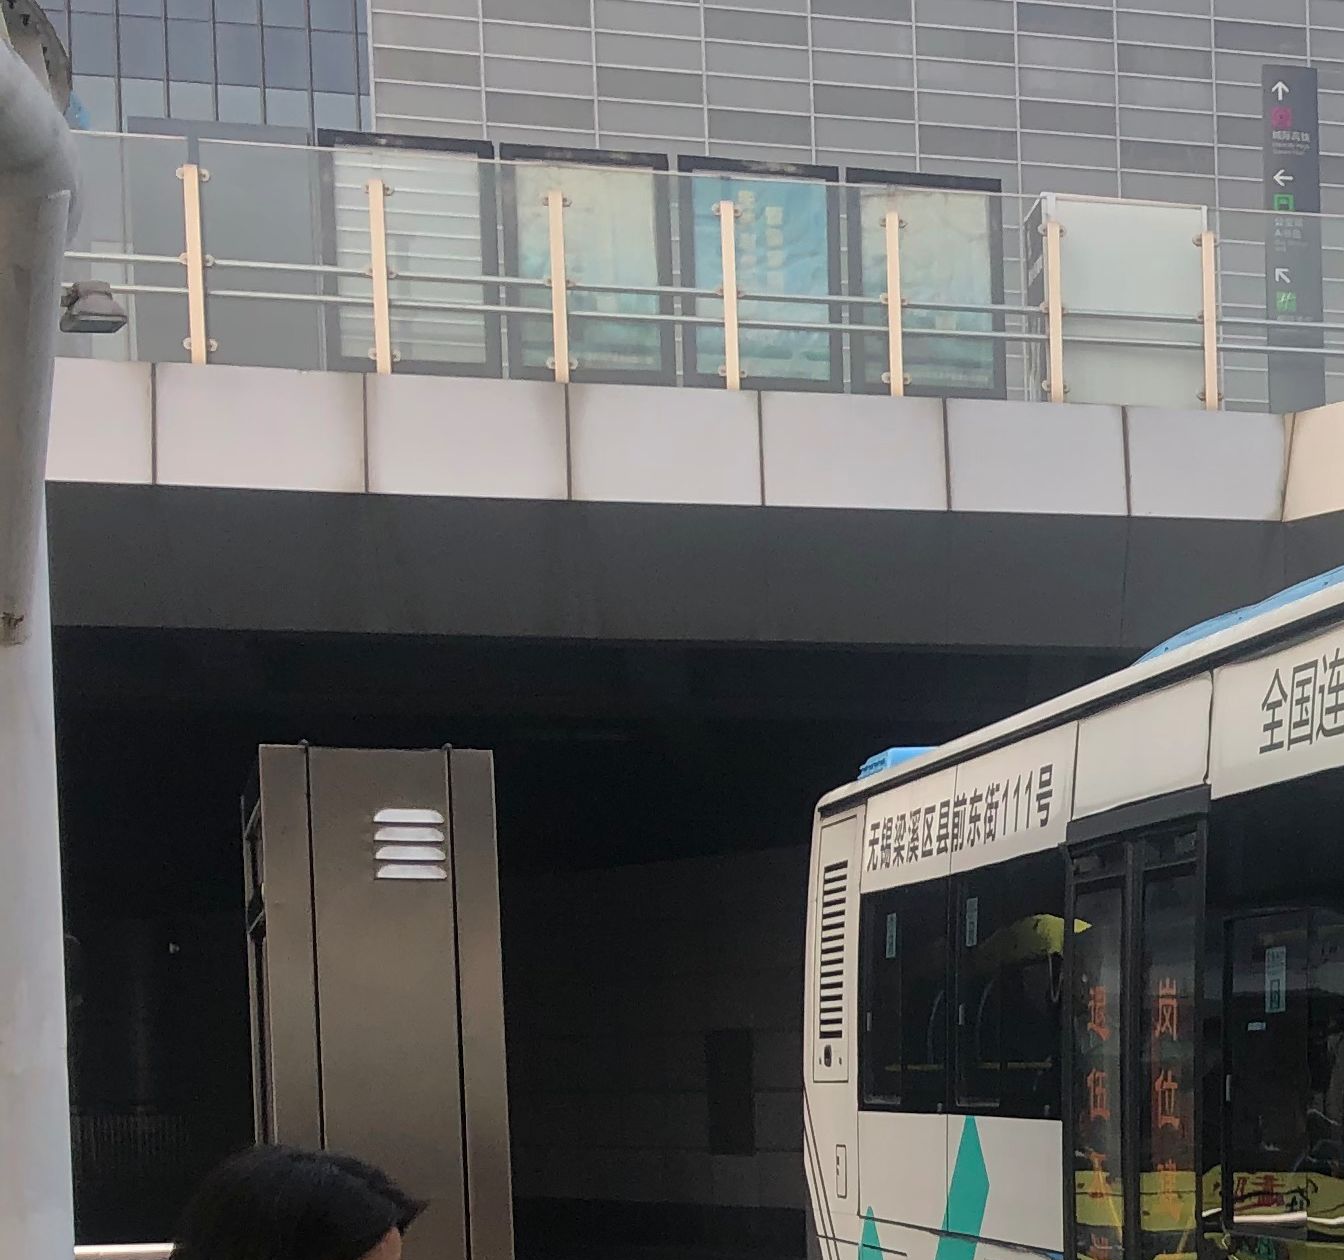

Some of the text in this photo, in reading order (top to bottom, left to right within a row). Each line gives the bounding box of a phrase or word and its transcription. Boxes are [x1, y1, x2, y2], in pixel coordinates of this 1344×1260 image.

[866, 763, 1054, 873] 无锡梁溪区县前东街111号
